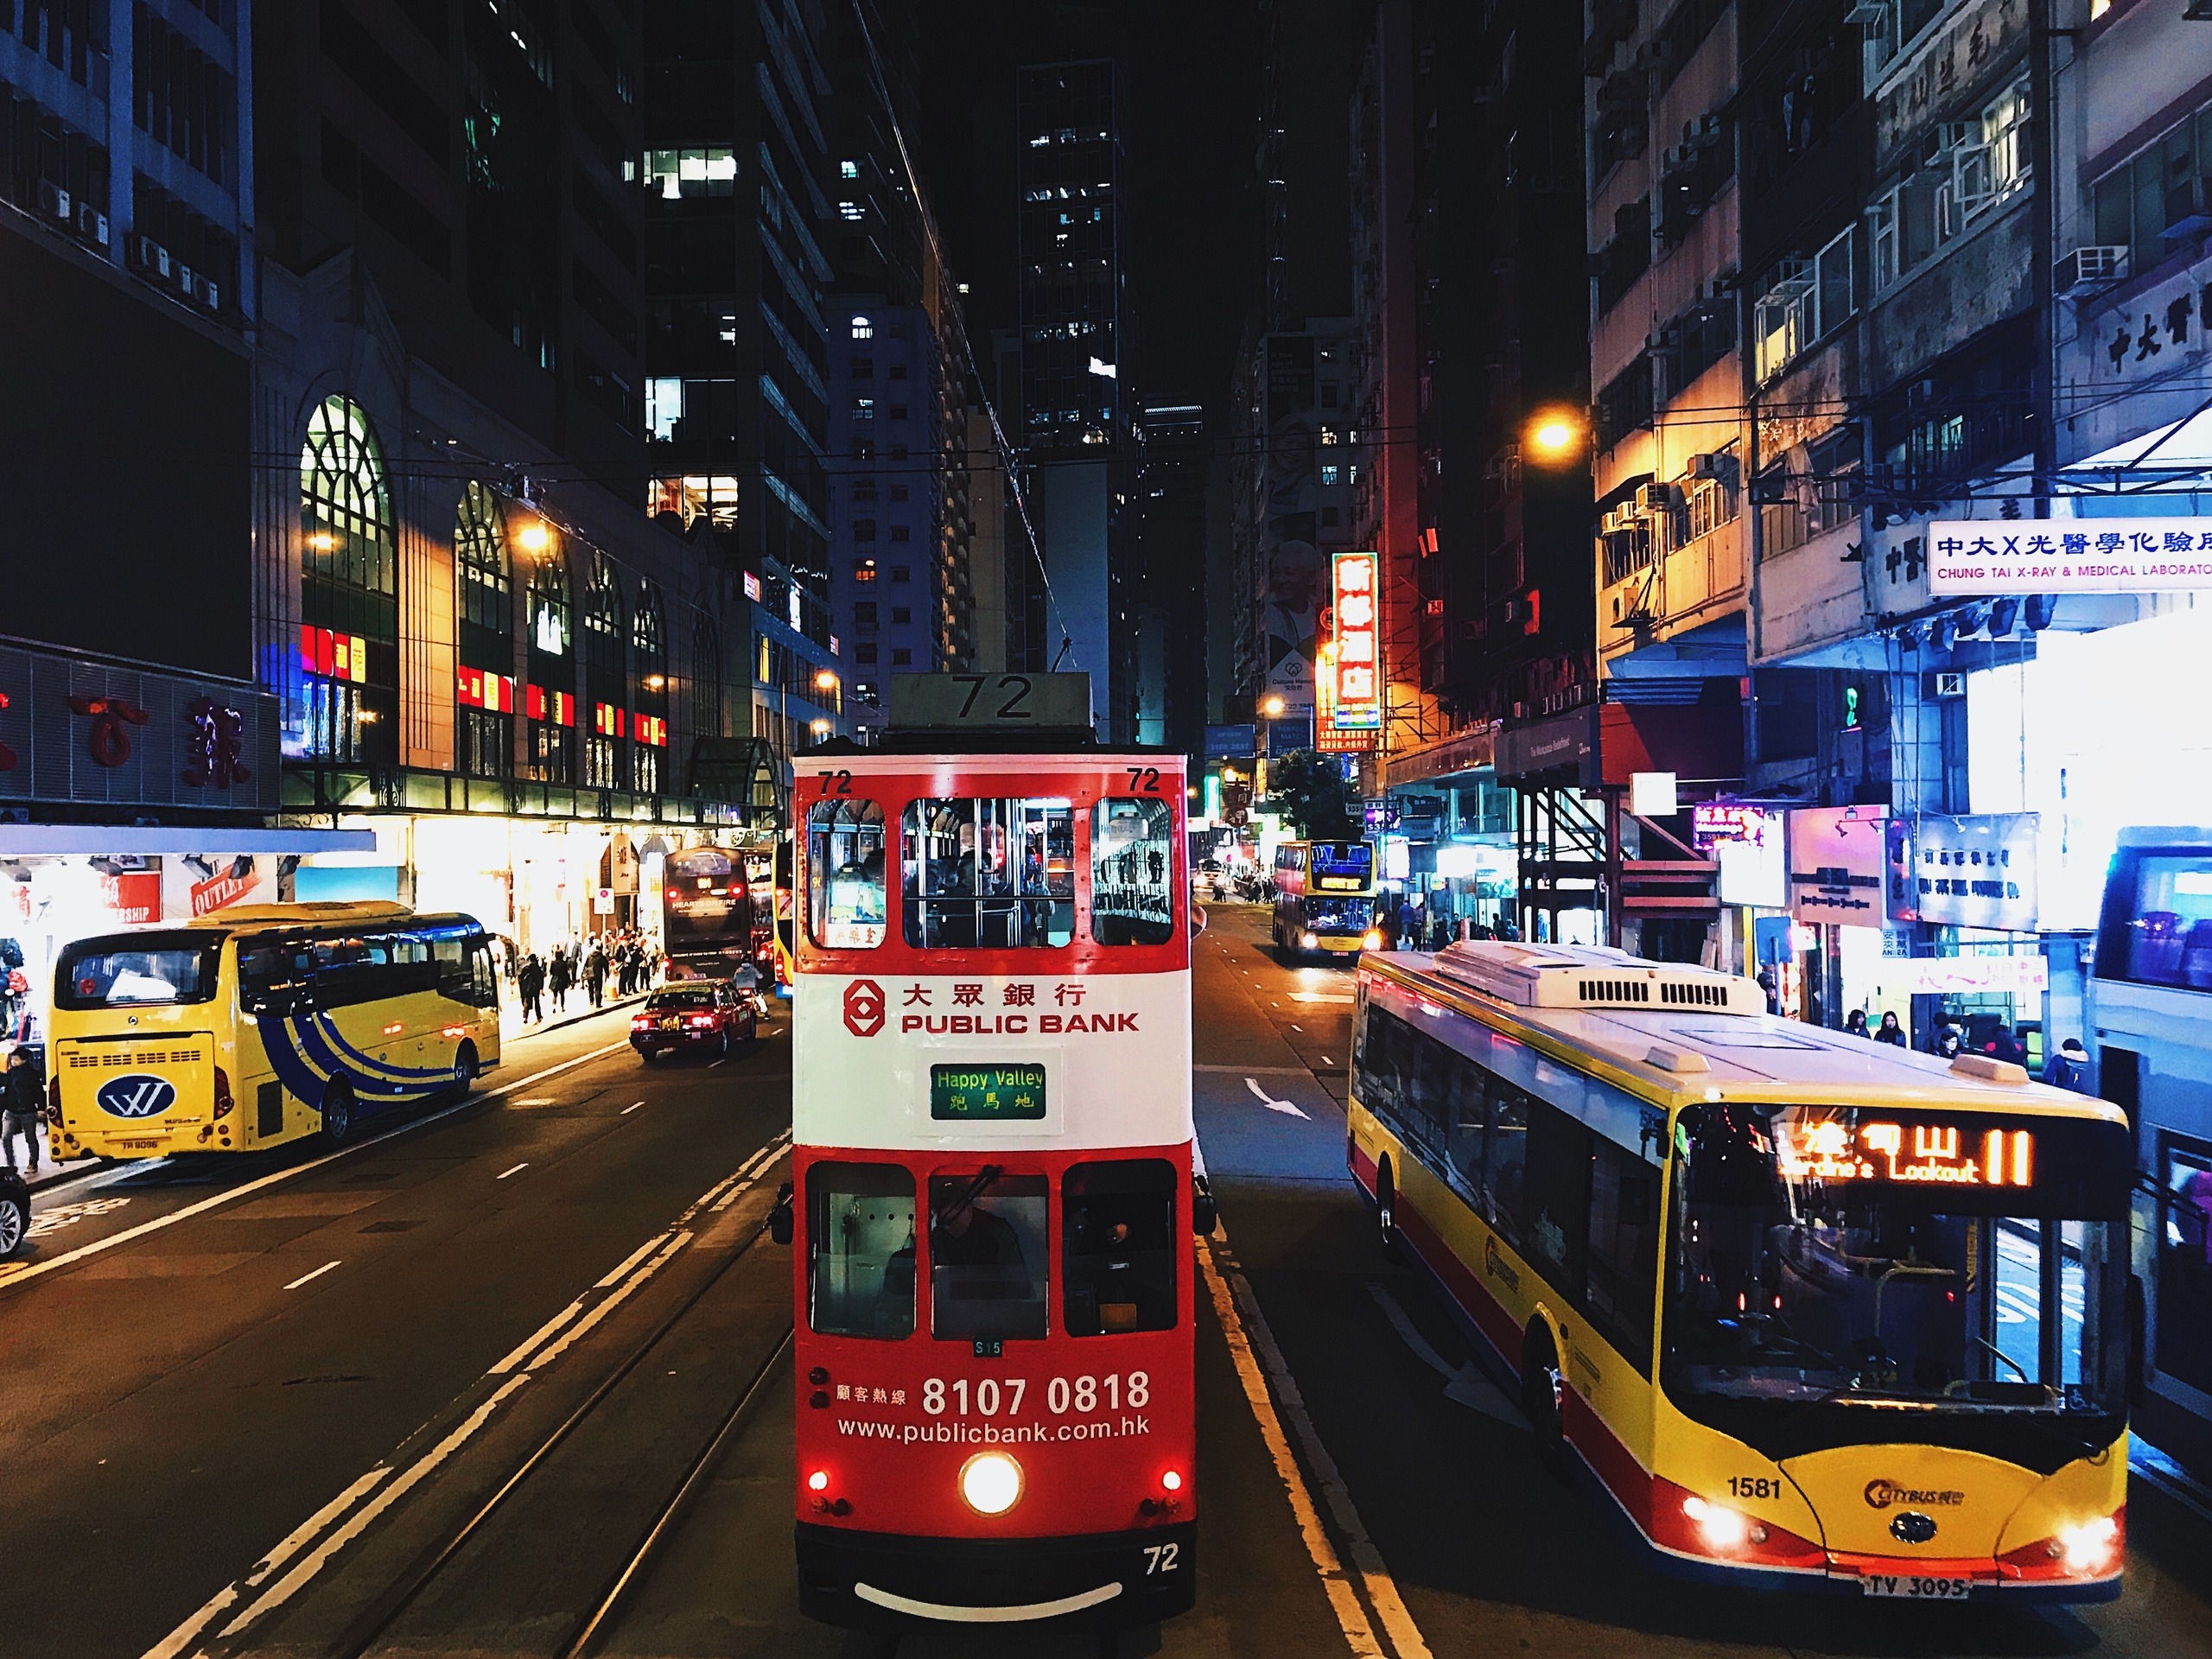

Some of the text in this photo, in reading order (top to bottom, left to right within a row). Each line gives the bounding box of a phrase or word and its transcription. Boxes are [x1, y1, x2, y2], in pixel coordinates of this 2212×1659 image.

[1937, 563, 2212, 579] CHUNG TAI X-RAY & MEDICAL LABORATO
[951, 676, 1032, 719] 72
[818, 770, 852, 794] 72
[1126, 767, 1160, 791] 72
[194, 878, 244, 915] OUTLET
[672, 899, 704, 909] HEARTS
[902, 983, 1086, 1007] 大眾銀行
[901, 1013, 1140, 1034] PUBLIC BANK
[938, 1069, 1044, 1090] Happy Valley
[950, 1092, 1034, 1111] 跑馬地
[1986, 1128, 2031, 1186] 11
[1890, 1158, 1980, 1184] Lookout
[836, 1370, 1149, 1416] 顧客熱線 8107 0818
[837, 1414, 1150, 1446] www.publicbank.com.hk
[1728, 1476, 1781, 1499] 1581
[1144, 1542, 1179, 1574] 72
[1870, 1575, 1966, 1597] TV 3095
